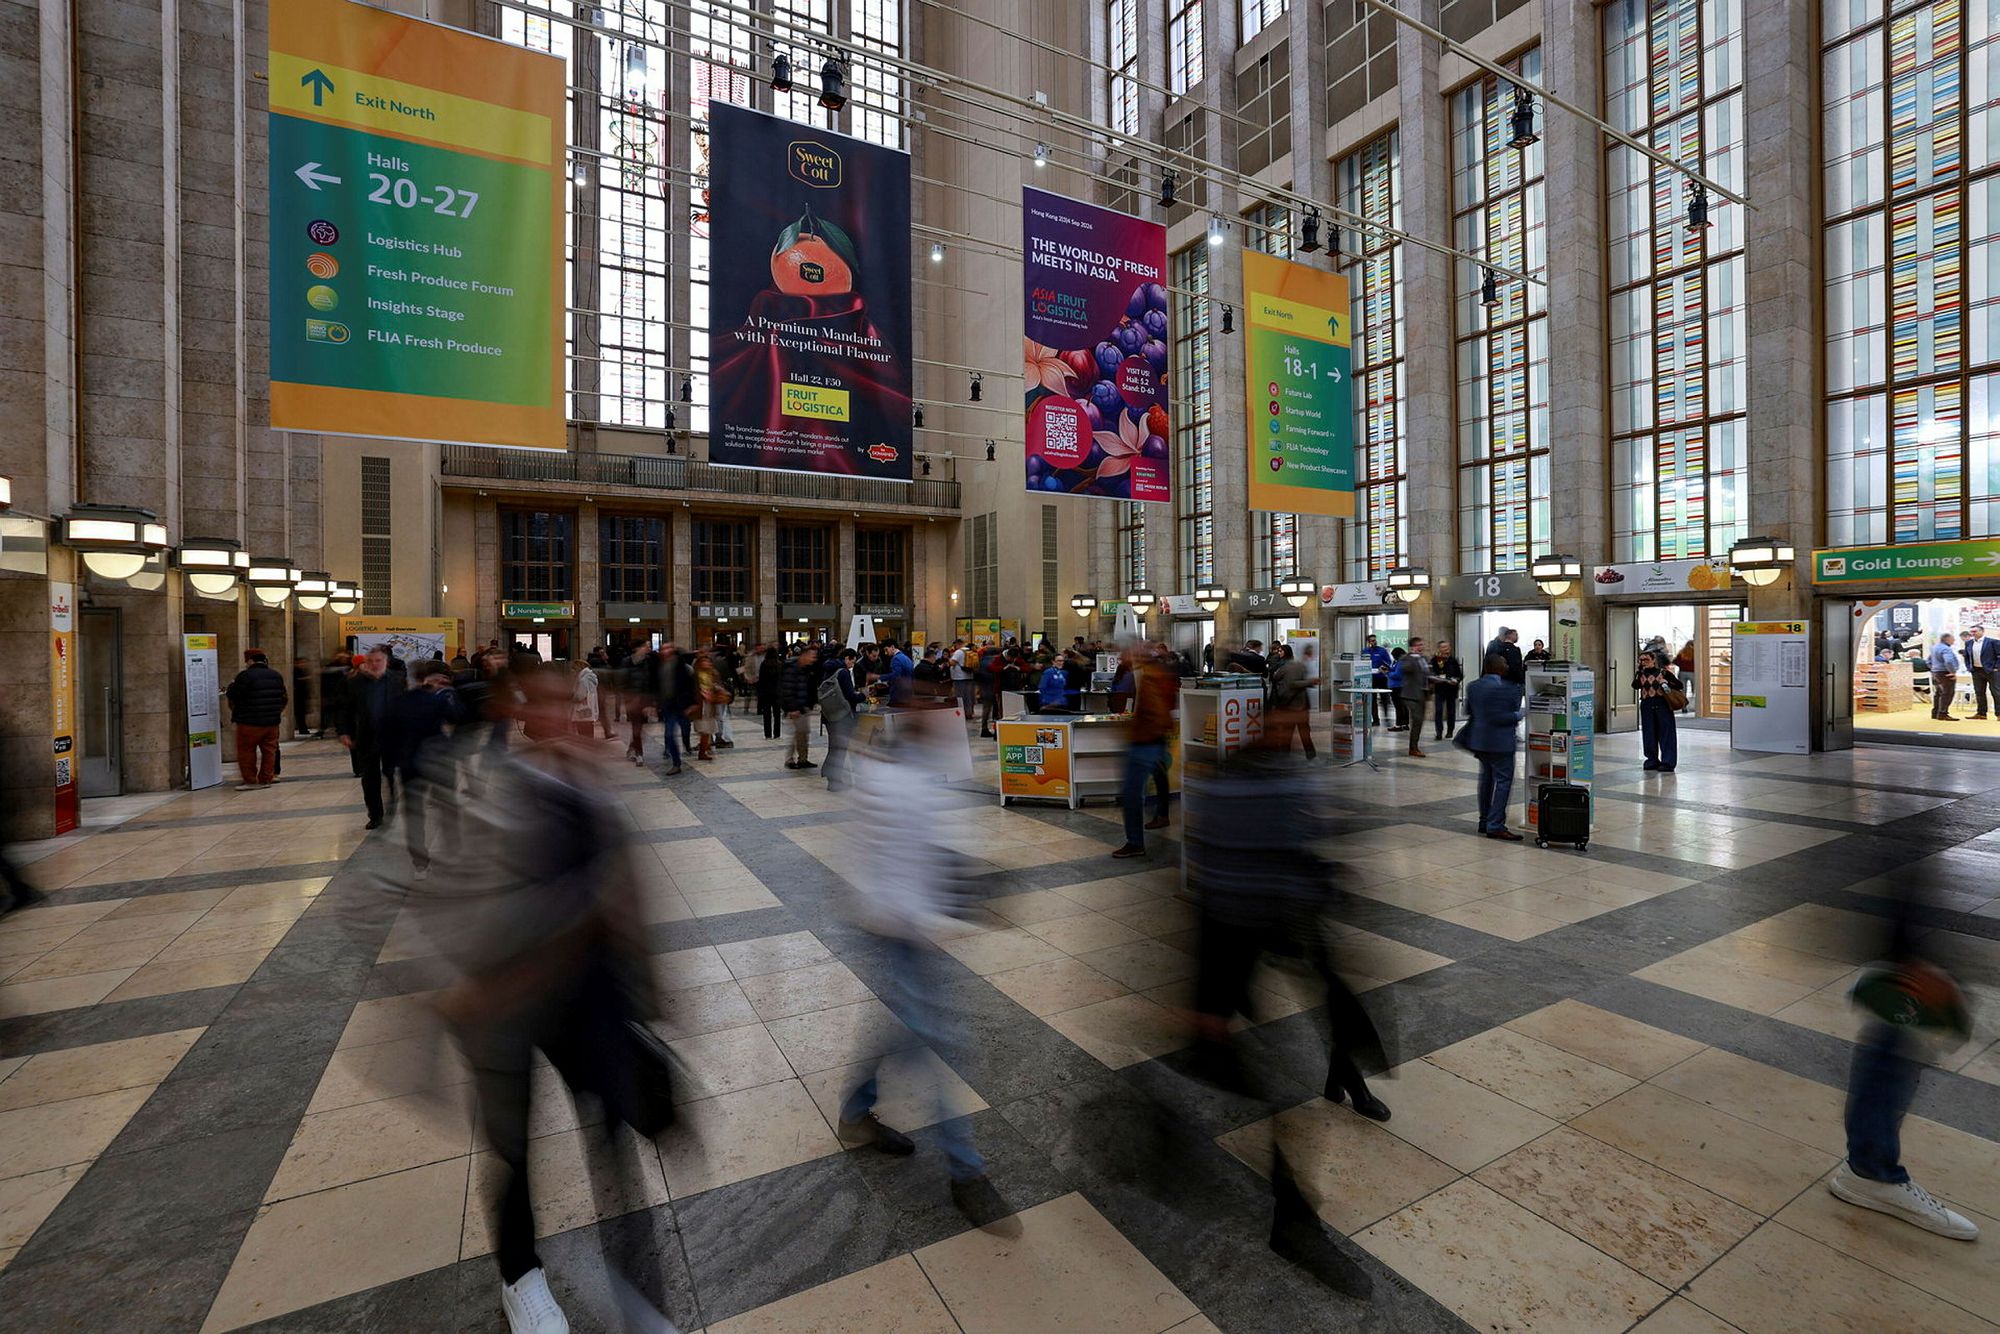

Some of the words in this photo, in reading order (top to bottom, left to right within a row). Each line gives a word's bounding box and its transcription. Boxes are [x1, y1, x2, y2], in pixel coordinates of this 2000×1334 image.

[355, 92, 386, 110] Exit
[389, 101, 436, 121] North
[367, 152, 409, 172] Halls
[796, 147, 833, 169] Sweet
[801, 162, 829, 181] Cott
[368, 173, 479, 219] 20-27
[1030, 208, 1045, 218] Hong
[1045, 211, 1058, 222] Kong
[1071, 218, 1080, 227] Sep
[367, 232, 430, 254] Logistics
[433, 244, 462, 258] Hub
[1031, 236, 1057, 254] THE
[1058, 243, 1104, 268] WORLD
[1106, 256, 1122, 270] OF
[1124, 261, 1159, 279] FRESH
[1032, 252, 1072, 271] MEETS
[1075, 261, 1088, 275] IN
[1089, 265, 1119, 283] ASIA.
[367, 265, 408, 282] Fresh
[411, 272, 468, 290] Produce
[471, 281, 514, 296] Forum
[1032, 287, 1056, 303] ASIA
[1057, 293, 1087, 309] FRUIT
[367, 297, 423, 317] Insights
[426, 305, 465, 322] Stage
[1032, 300, 1088, 322] LOGISTICA
[1263, 306, 1276, 317] Exit
[1276, 310, 1294, 320] North
[744, 315, 755, 327] A
[758, 316, 818, 337] Premium
[822, 327, 882, 348] Mandarin
[367, 329, 401, 344] FLIA
[405, 334, 443, 350] Fresh
[447, 340, 502, 356] Produce
[734, 330, 766, 345] with
[770, 334, 843, 356] Exceptional
[847, 343, 892, 363] Flavour
[1284, 345, 1300, 355] Halls
[1126, 367, 1139, 375] VISIT
[1284, 356, 1317, 380] 18-1
[790, 372, 809, 383] Hall
[825, 377, 841, 387] F50
[787, 389, 818, 401] FRUIT
[1122, 383, 1139, 393] Stand:
[1140, 386, 1155, 395] D-63
[1285, 388, 1302, 398] Future
[1302, 390, 1312, 399] Lab
[787, 399, 844, 416] LOGISTICA
[1285, 407, 1305, 417] Startup
[1305, 409, 1321, 419] World
[724, 424, 735, 432] The
[799, 432, 823, 441] mandarin
[824, 434, 840, 442] stands
[1286, 425, 1307, 436] Farming
[1307, 428, 1329, 437] Forward
[724, 440, 745, 448] solution
[774, 445, 787, 453] easy
[744, 435, 775, 444] exceptional
[800, 439, 817, 448] brings
[822, 443, 844, 451] premium
[1300, 444, 1329, 456] Technology
[1286, 461, 1300, 470] New
[1300, 463, 1320, 471] Product
[1321, 465, 1348, 475] Showcases
[1851, 558, 1892, 571] Gold
[1896, 554, 1964, 572] Lounge
[1474, 577, 1501, 597] 18
[1248, 594, 1259, 606] 18
[1268, 594, 1275, 605] 7
[517, 607, 542, 615] Nursing
[1786, 623, 1801, 632] 18
[1005, 752, 1023, 760] APP
